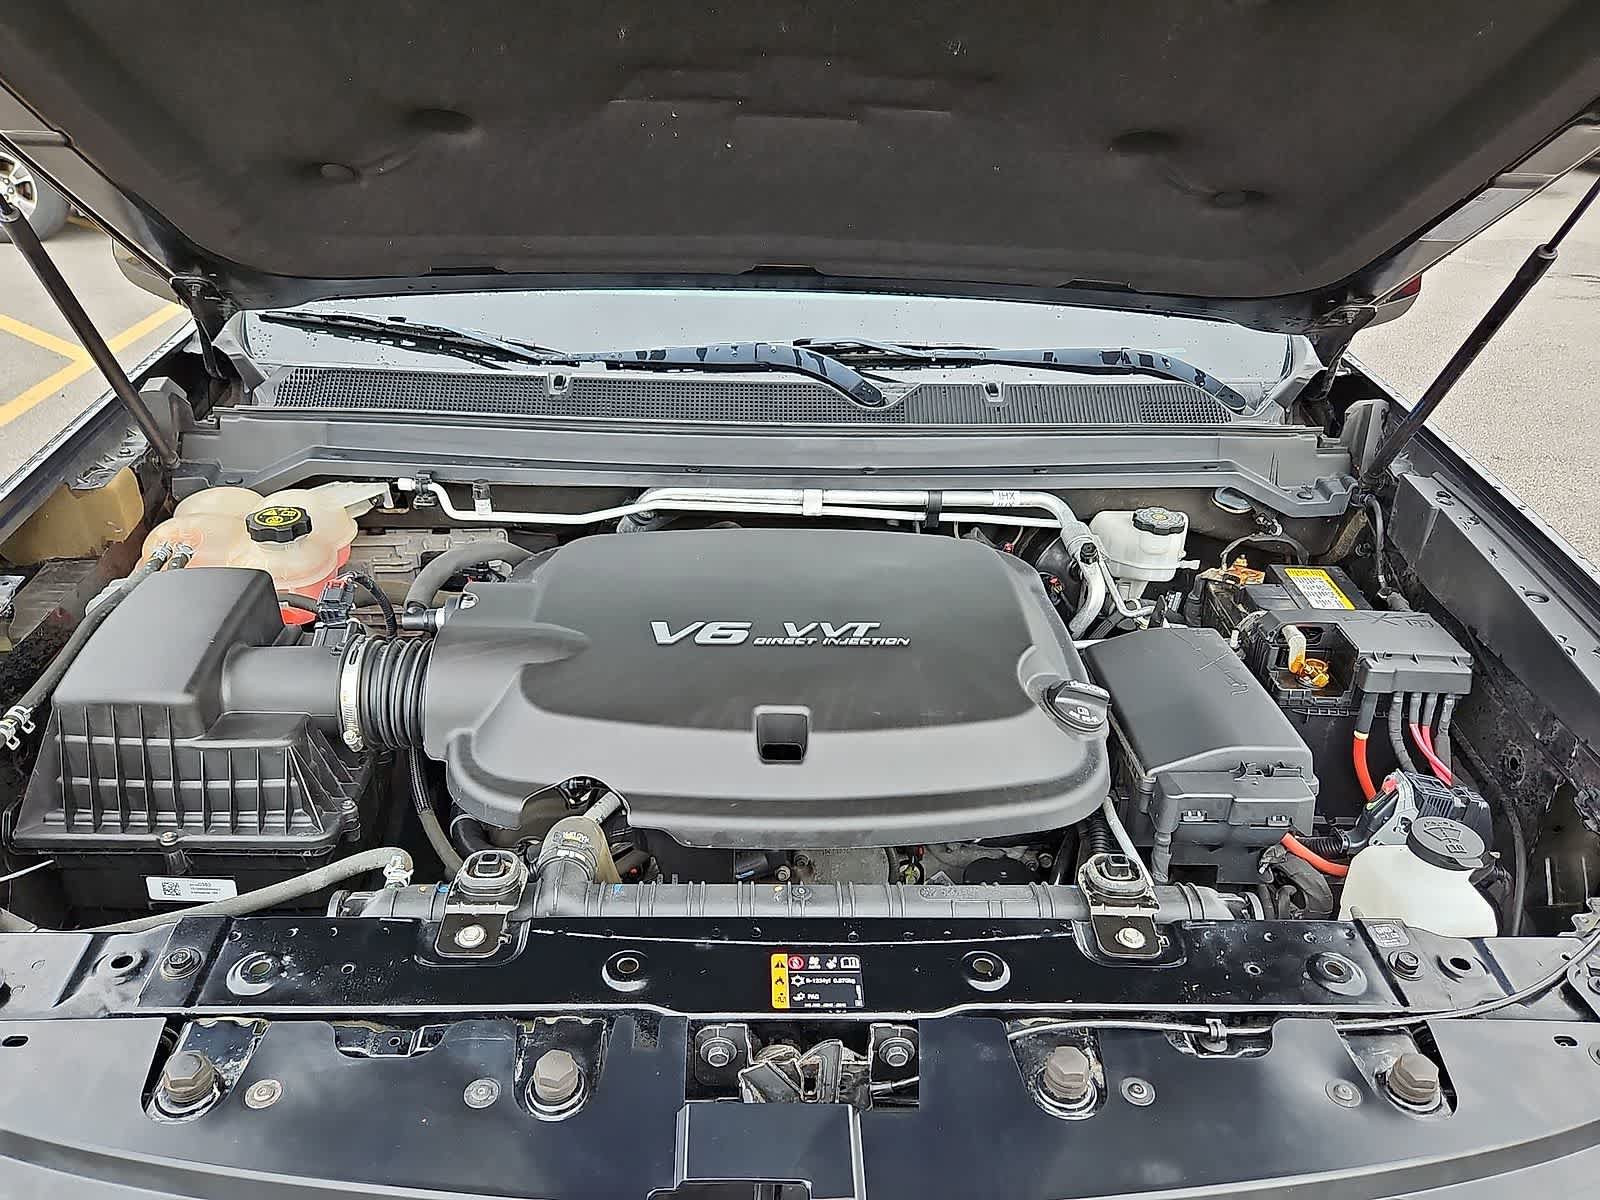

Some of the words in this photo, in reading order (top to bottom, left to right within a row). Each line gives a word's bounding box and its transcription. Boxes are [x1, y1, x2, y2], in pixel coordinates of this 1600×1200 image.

[650, 621, 753, 645] V6
[783, 622, 881, 638] VVT
[752, 637, 818, 646] DIRECT
[821, 637, 911, 646] INJECTION
